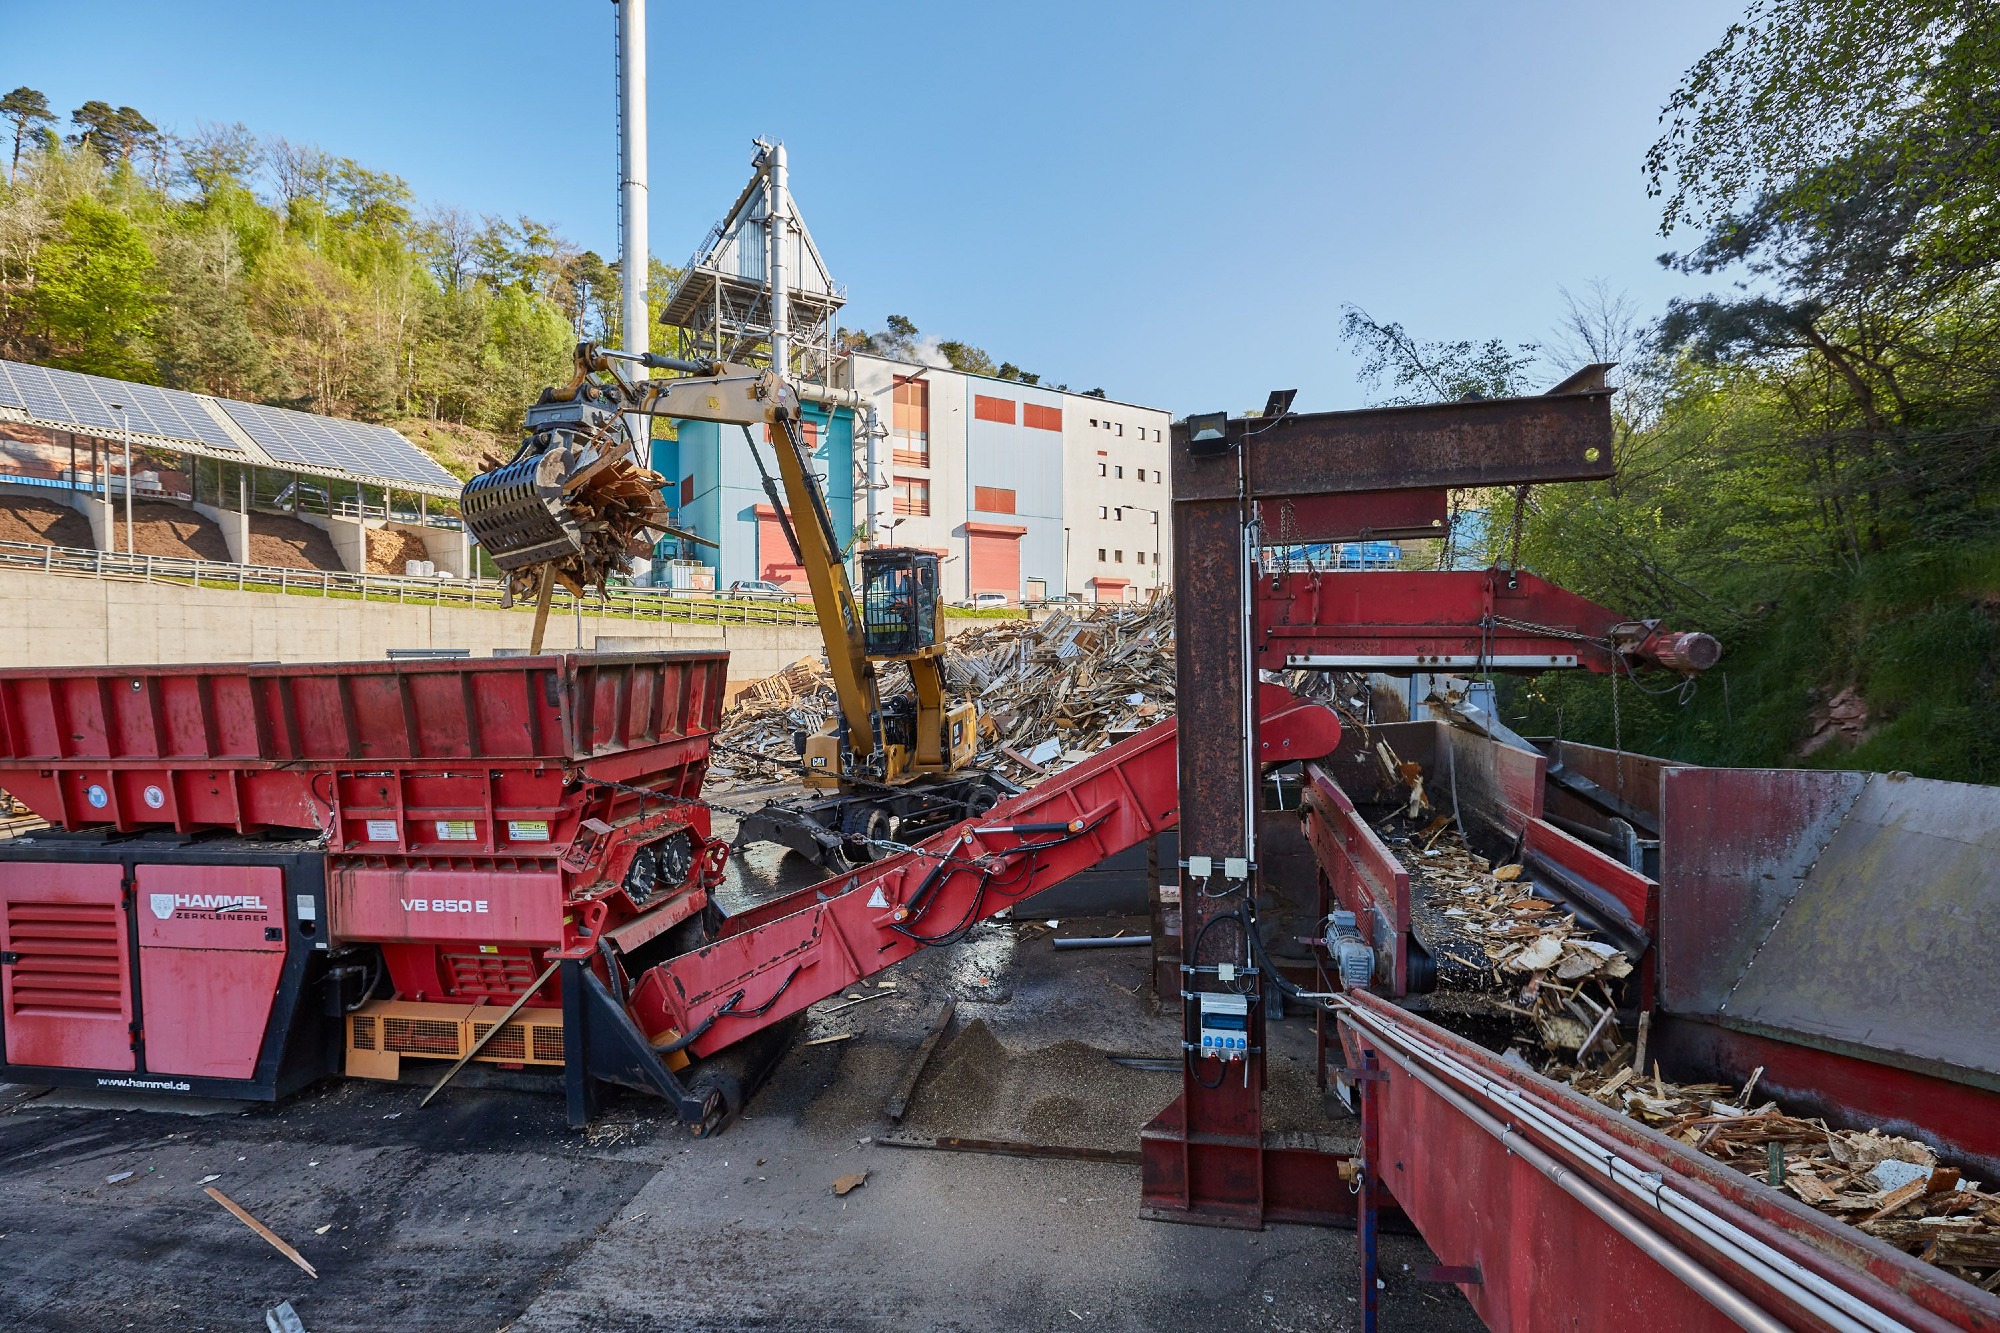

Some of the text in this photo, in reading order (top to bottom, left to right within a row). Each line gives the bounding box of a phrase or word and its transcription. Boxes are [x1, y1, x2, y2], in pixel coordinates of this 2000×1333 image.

[843, 606, 853, 631] CAT
[812, 757, 826, 767] CAT
[175, 894, 267, 909] HAMMEL
[400, 899, 488, 913] VB 850 E
[176, 912, 268, 922] ZERKLEINERER
[97, 1078, 191, 1091] www.hammel.de
